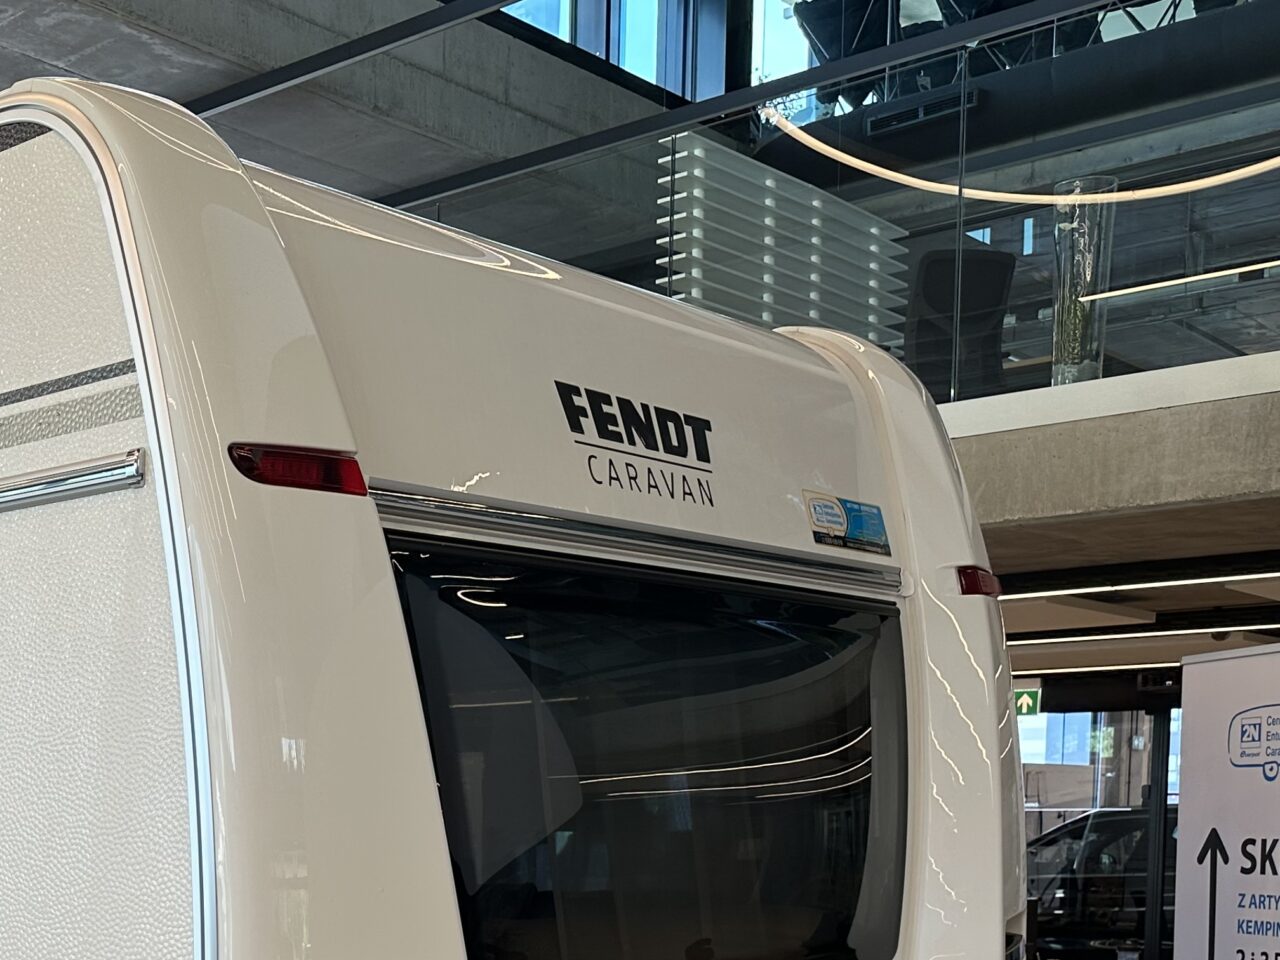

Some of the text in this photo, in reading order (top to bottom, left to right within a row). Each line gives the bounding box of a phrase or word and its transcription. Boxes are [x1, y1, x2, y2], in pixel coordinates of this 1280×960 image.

[554, 379, 712, 464] FENDT
[587, 454, 715, 508] CARAVAN
[1241, 724, 1260, 742] 2N
[1240, 837, 1280, 875] SK
[1237, 893, 1246, 908] Z
